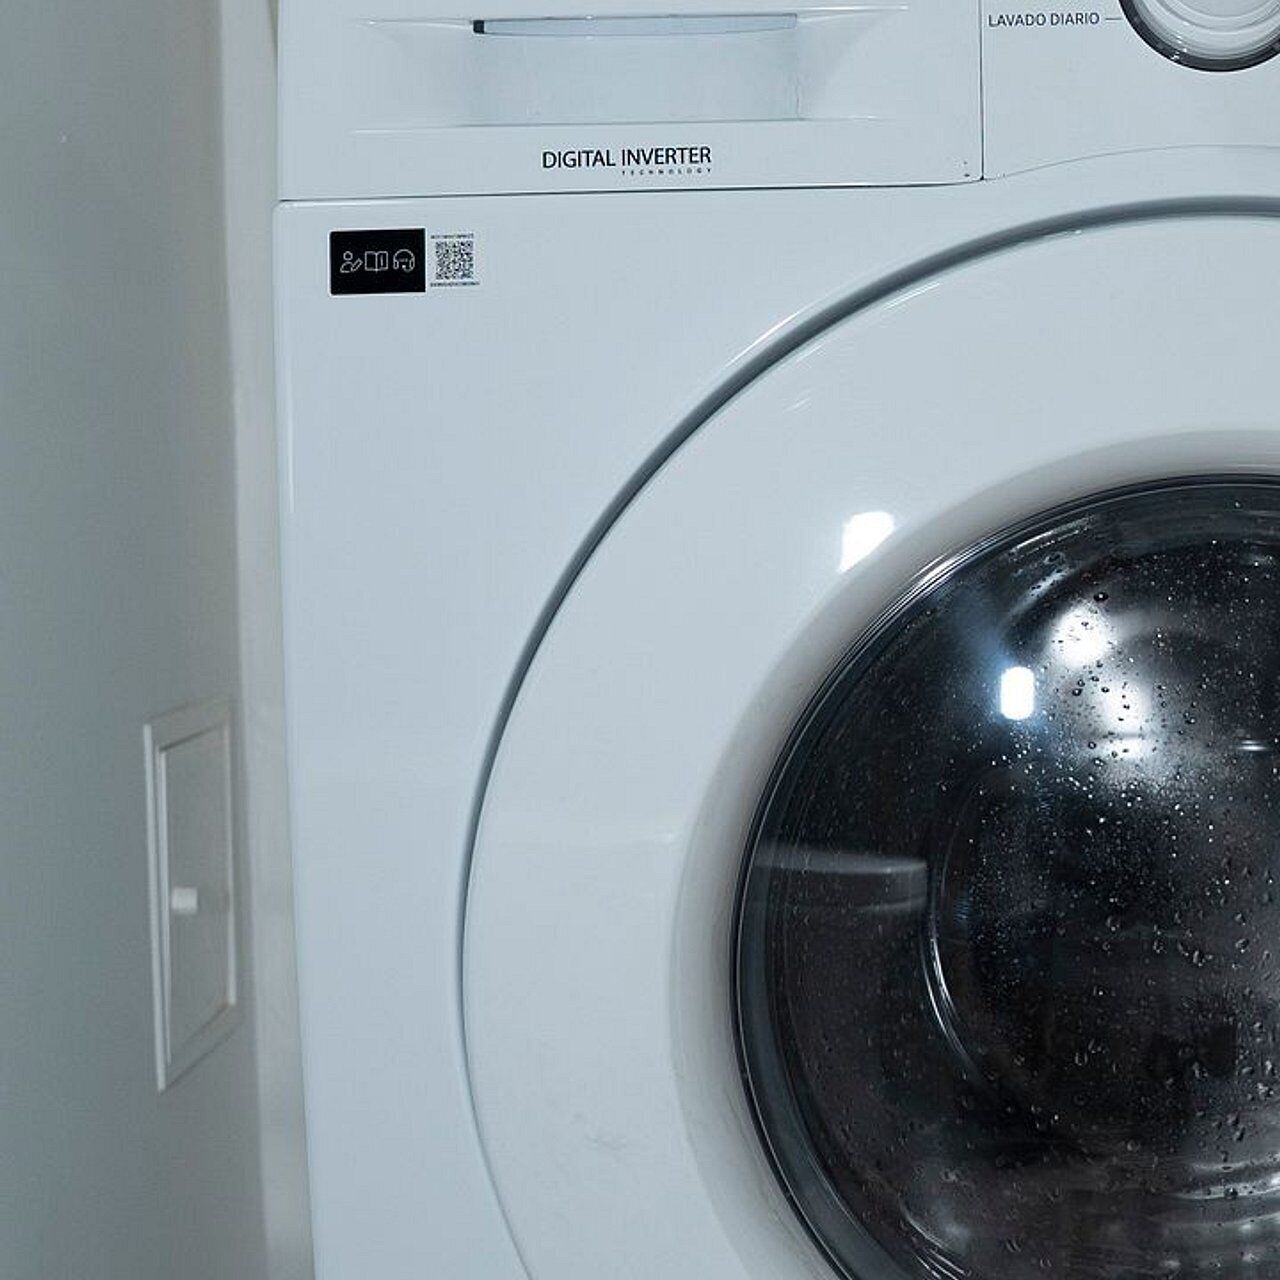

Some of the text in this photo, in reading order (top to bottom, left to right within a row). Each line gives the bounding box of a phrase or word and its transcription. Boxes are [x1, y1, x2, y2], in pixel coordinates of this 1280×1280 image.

[988, 12, 1100, 27] LAVADO DIARIO
[542, 146, 712, 169] DIGITAL INVERTER
